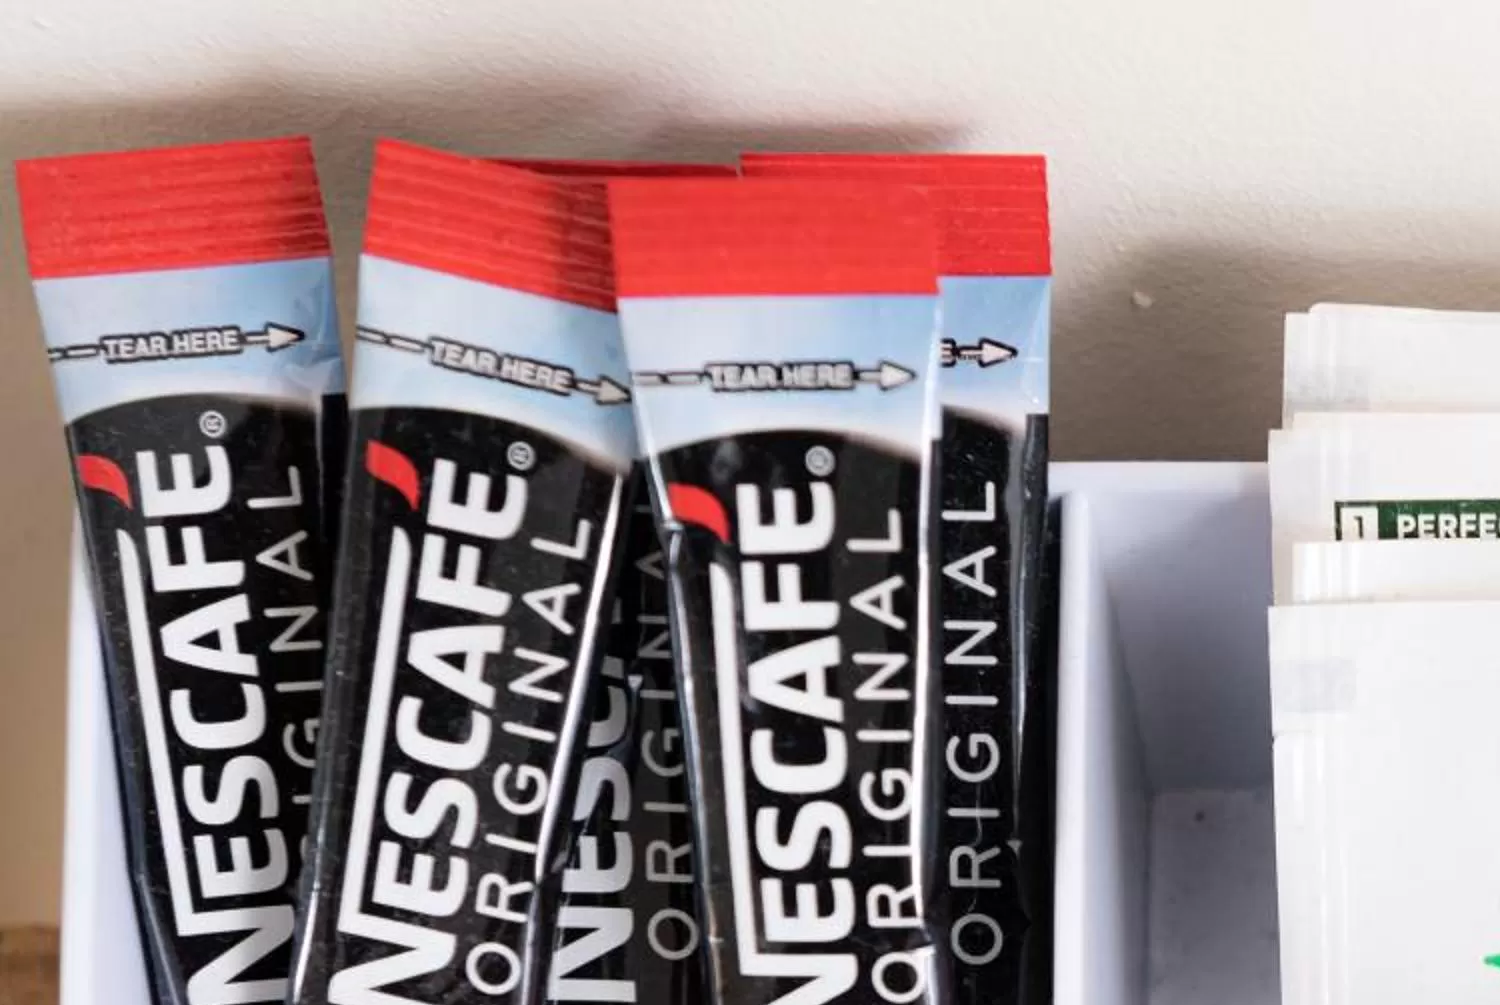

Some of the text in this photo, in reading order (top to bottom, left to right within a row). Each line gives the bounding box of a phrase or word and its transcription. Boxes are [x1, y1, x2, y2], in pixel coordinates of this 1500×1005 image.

[103, 328, 240, 360] TEAR HERE
[430, 338, 573, 393] TEAR HERE
[709, 362, 852, 389] TEAR HERE
[466, 518, 592, 996] ORIGINAL
[846, 507, 933, 1004] ORIGINAL
[942, 481, 1004, 965] ORIGINAL
